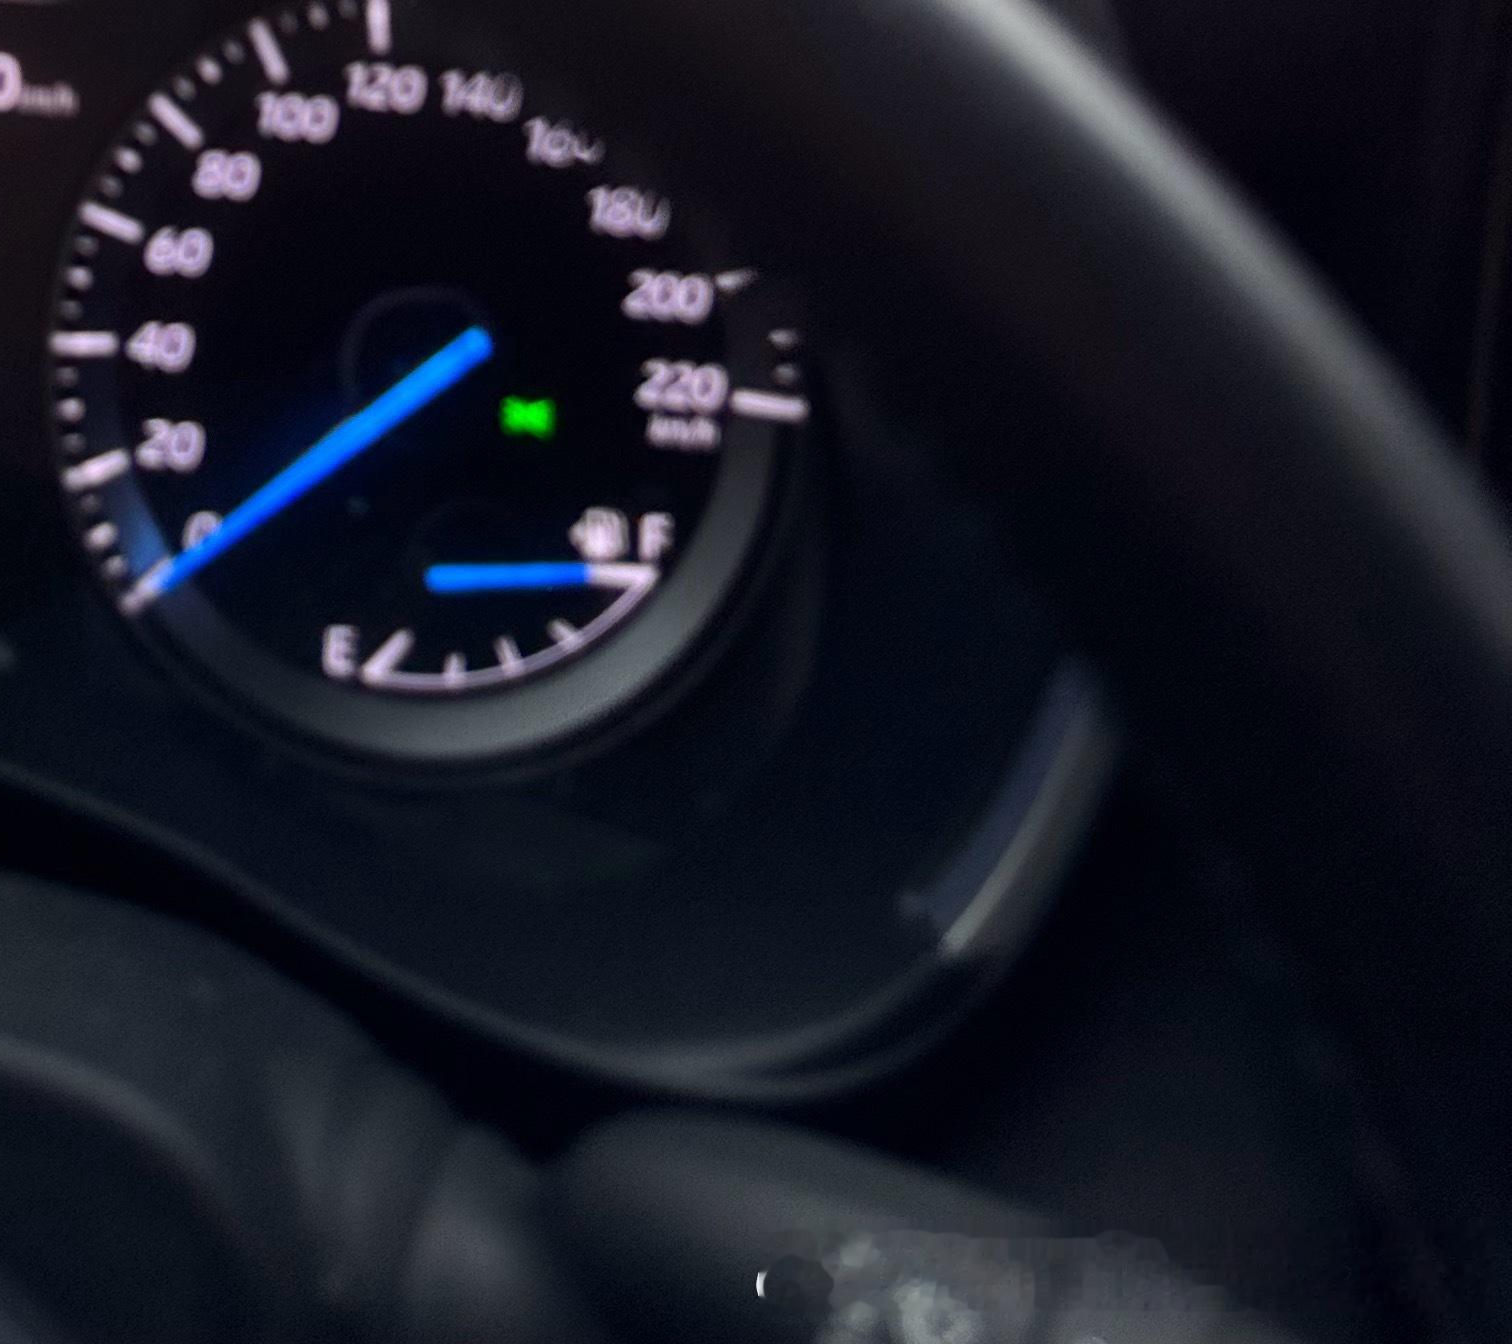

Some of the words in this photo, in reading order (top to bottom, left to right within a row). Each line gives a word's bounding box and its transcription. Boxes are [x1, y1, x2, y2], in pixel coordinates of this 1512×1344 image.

[345, 62, 428, 113] 120
[440, 69, 522, 122] 140
[256, 92, 339, 144] 100
[193, 149, 262, 202] 80
[588, 186, 671, 240] 180
[144, 226, 214, 277] 60
[621, 268, 714, 325] 200
[125, 320, 196, 373] 40
[634, 358, 728, 414] 220
[136, 417, 206, 473] 20
[638, 512, 674, 561] F
[322, 624, 358, 678] E
